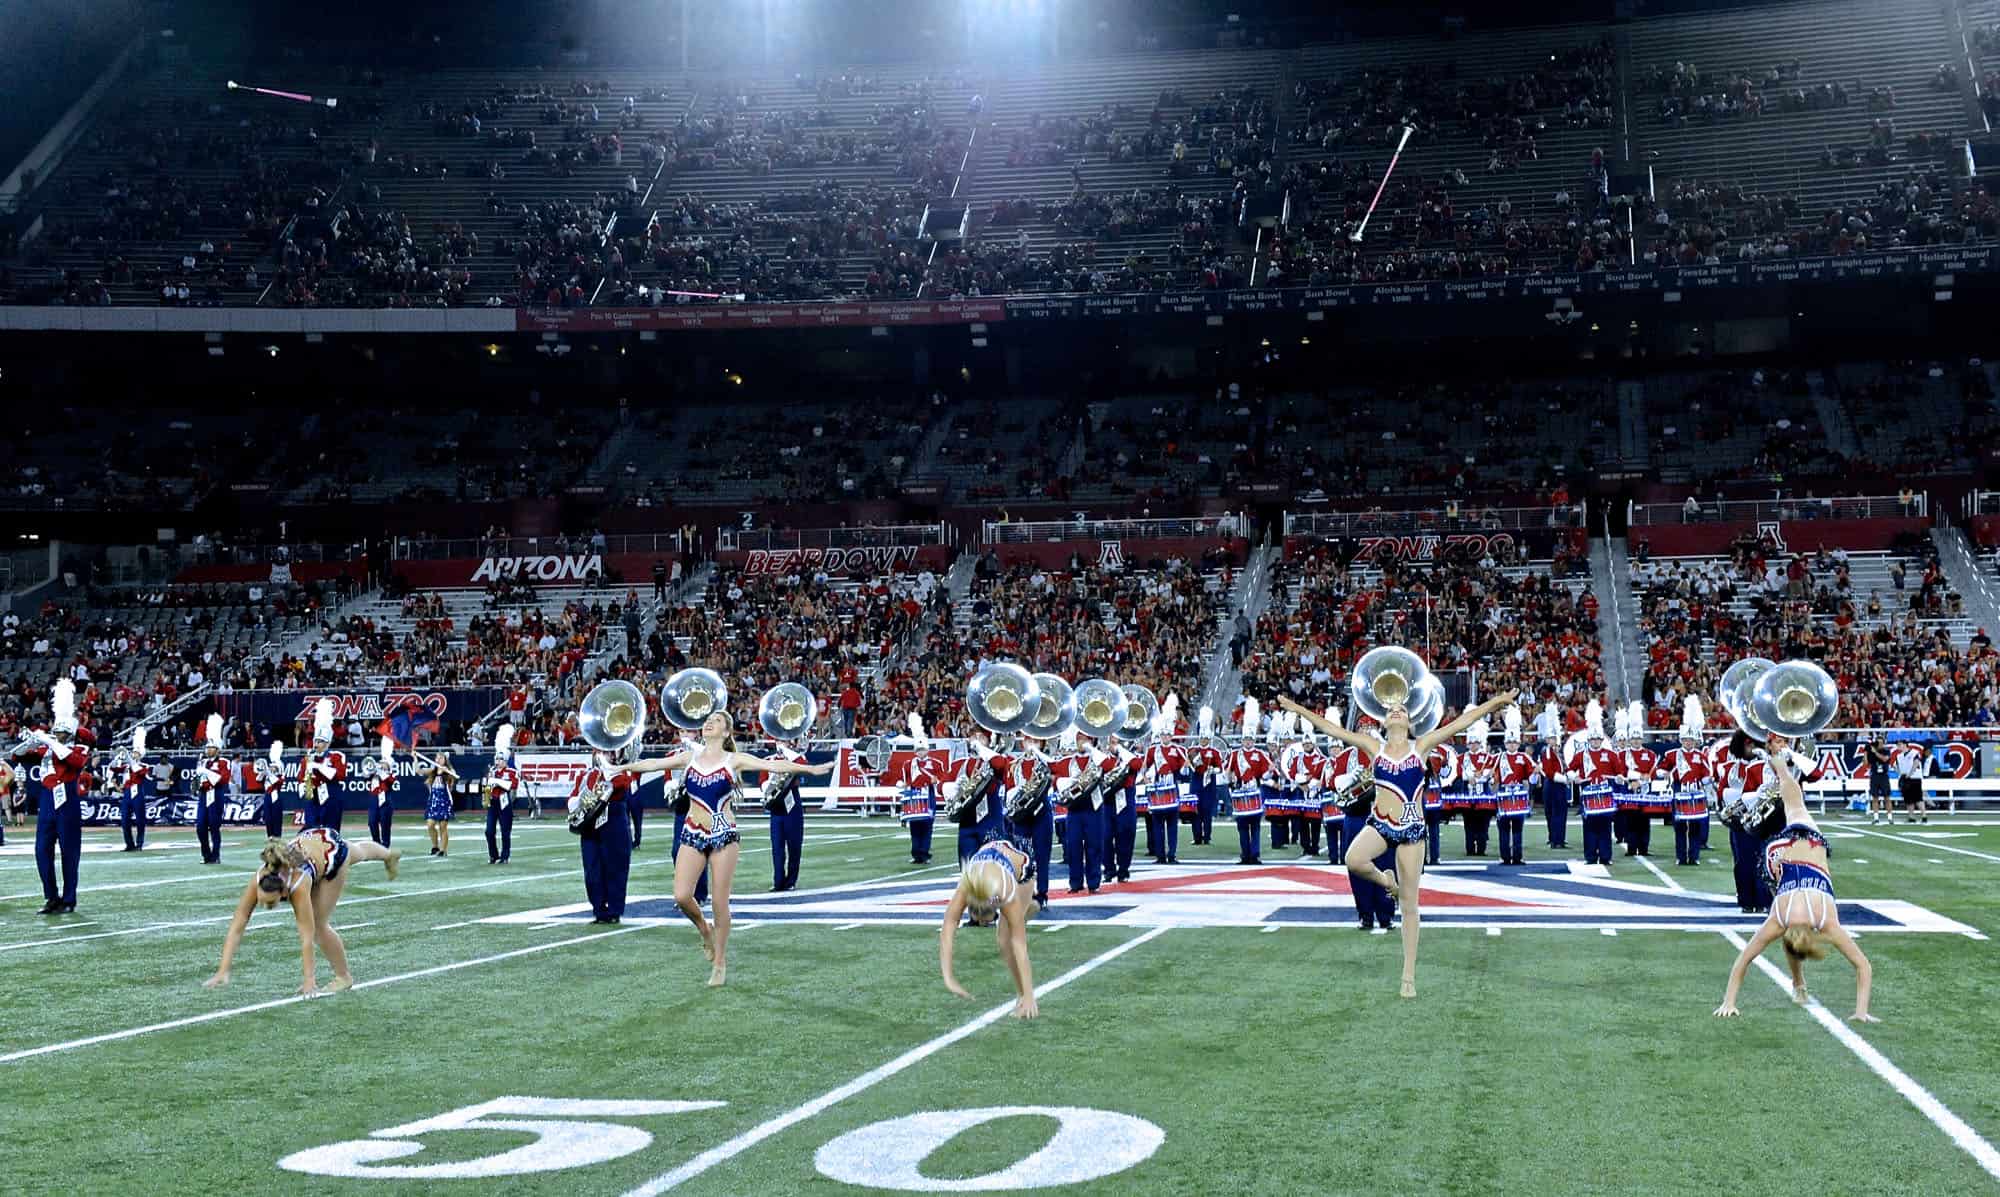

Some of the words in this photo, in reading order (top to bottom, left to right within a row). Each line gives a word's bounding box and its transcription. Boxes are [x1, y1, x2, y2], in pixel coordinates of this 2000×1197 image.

[1886, 255, 1909, 264] Bowl
[1919, 252, 1959, 262] Holiday
[1962, 249, 1990, 259] Bowl
[1711, 265, 1736, 275] Bowl
[1752, 264, 1796, 272] Freedom
[1798, 260, 1824, 270] Bowl
[1524, 278, 1552, 286] Aloha
[1555, 276, 1580, 284] Bowl
[1627, 272, 1653, 280] Bowl
[1375, 286, 1401, 294] Aloha
[1403, 285, 1427, 293] Bowl
[1445, 282, 1478, 291] Copper
[1481, 281, 1506, 289] Bowl
[1181, 295, 1205, 303] Bowl
[1258, 291, 1282, 300] Bowl
[1305, 290, 1324, 298] Sun
[1326, 288, 1350, 297] Bowl
[742, 513, 753, 527] 2
[1757, 522, 1787, 553] A
[1096, 541, 1126, 570] A
[470, 555, 602, 582] ARIZONA
[520, 764, 587, 782] ESPN
[96, 803, 166, 820] Baer
[1399, 802, 1420, 823] A
[710, 812, 730, 833] A
